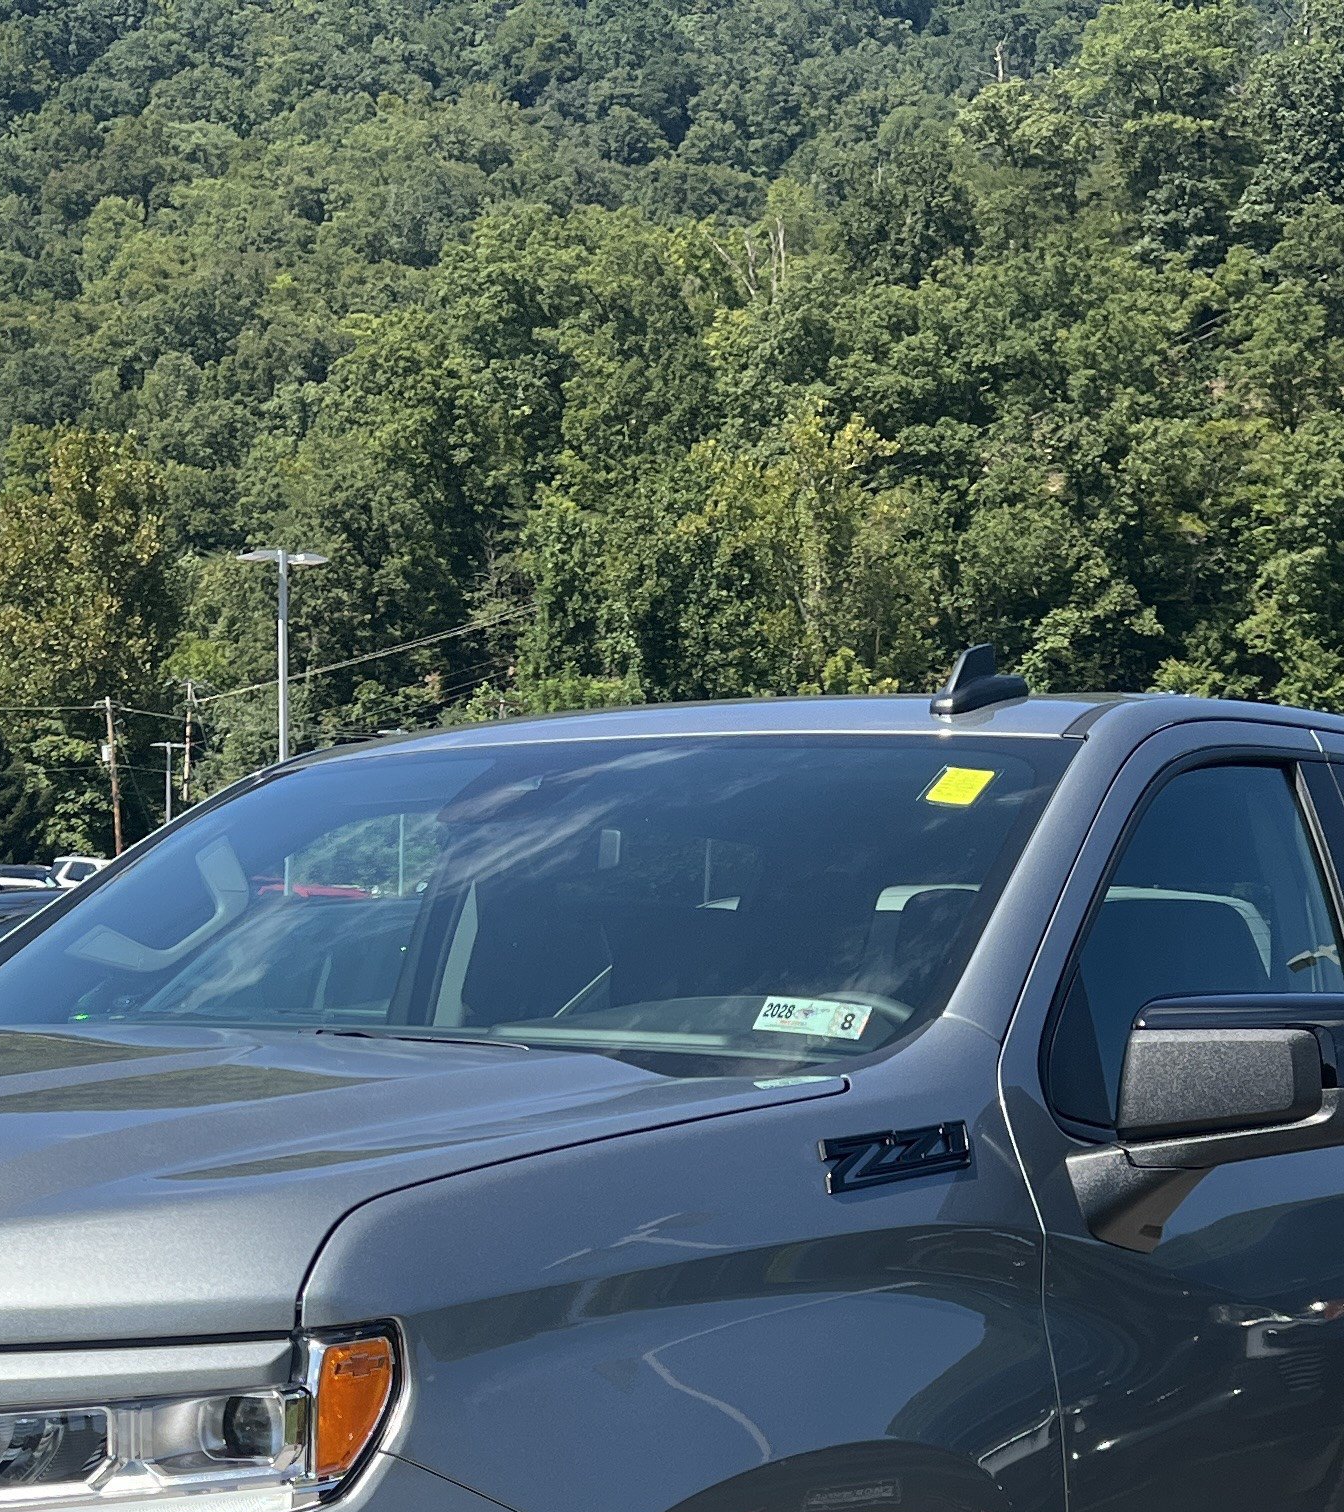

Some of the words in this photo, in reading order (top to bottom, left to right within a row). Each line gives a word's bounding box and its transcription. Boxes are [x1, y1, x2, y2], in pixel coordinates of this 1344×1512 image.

[763, 1003, 796, 1019] 2028
[840, 1013, 856, 1030] 8
[817, 1119, 972, 1195] Z71
